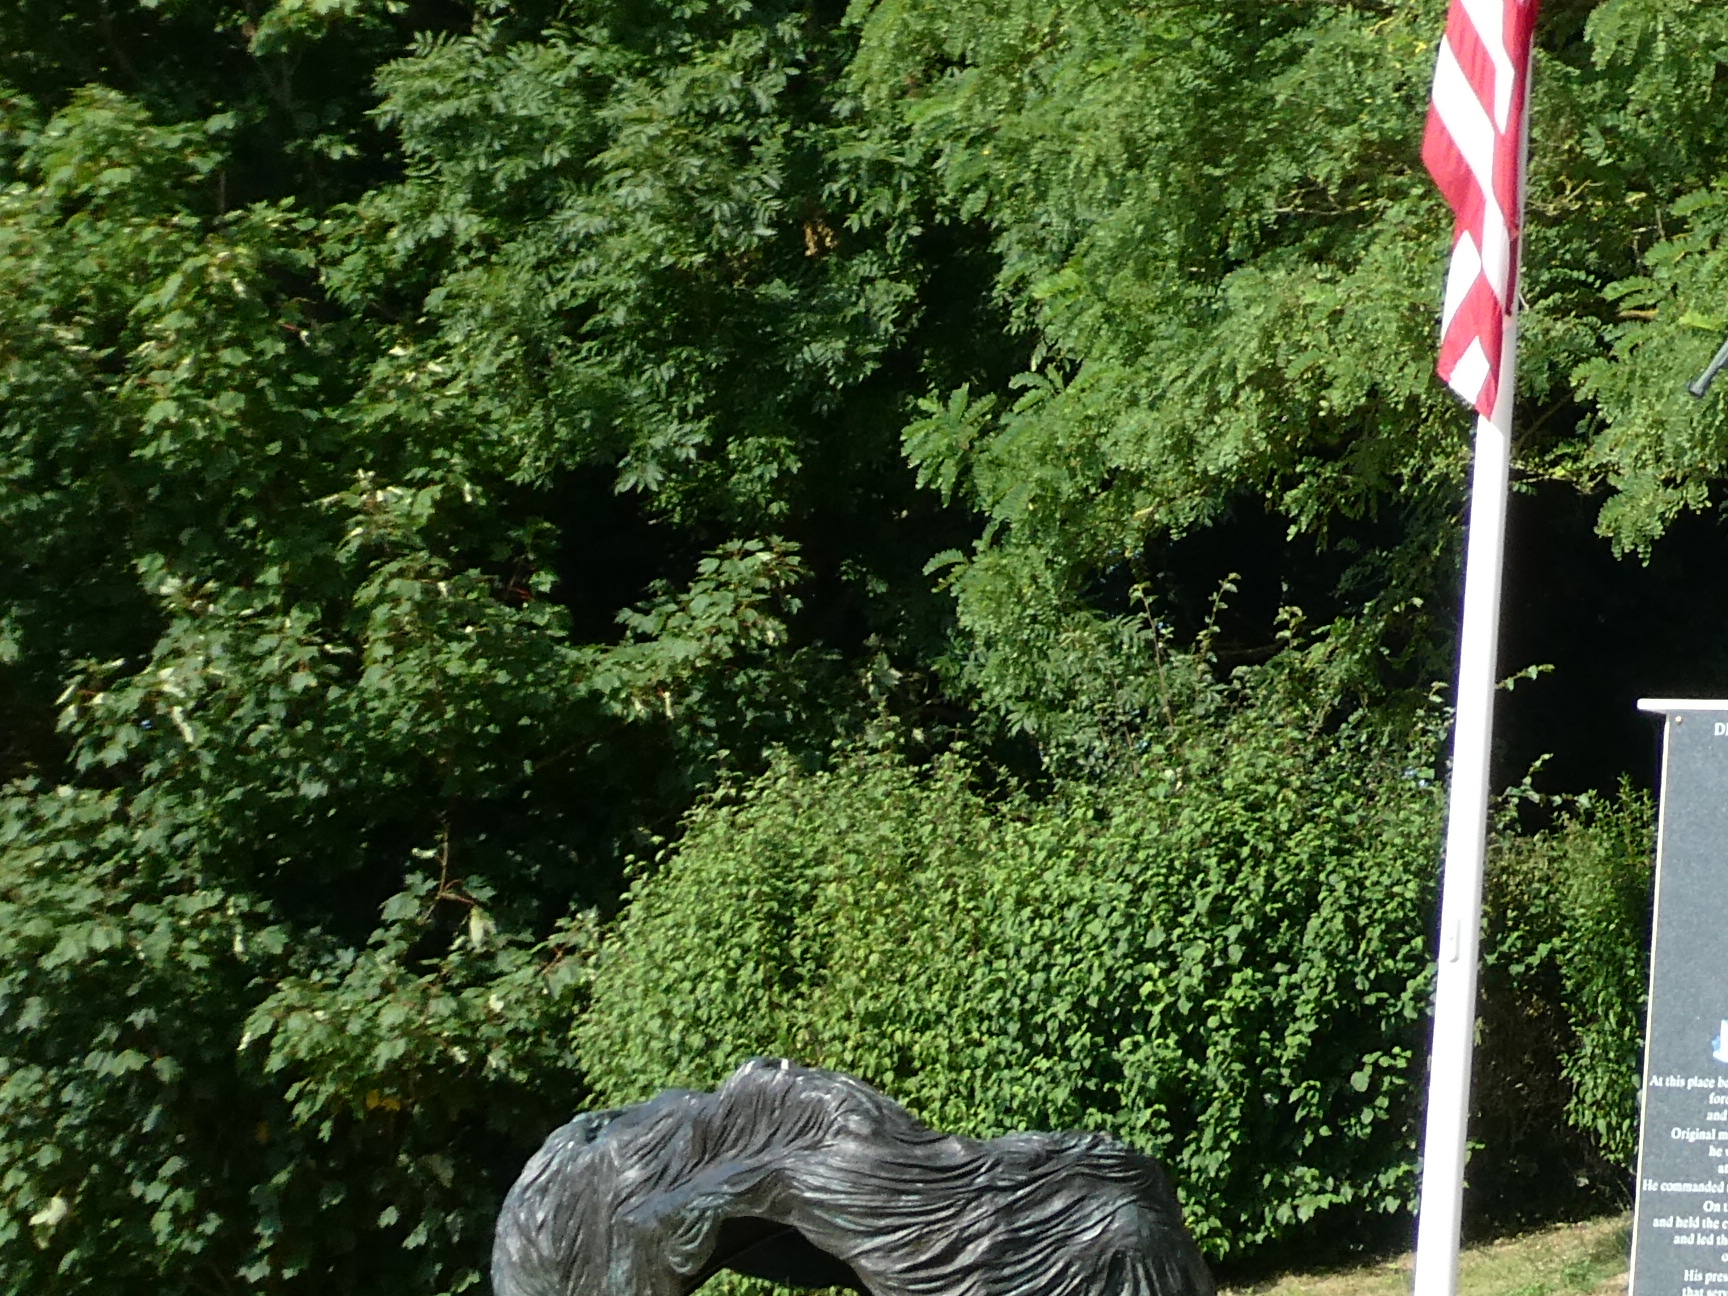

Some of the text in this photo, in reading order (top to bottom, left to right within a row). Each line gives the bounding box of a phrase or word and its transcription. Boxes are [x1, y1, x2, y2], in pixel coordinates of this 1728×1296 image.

[1649, 1075, 1662, 1086] At
[1665, 1074, 1685, 1087] this
[1686, 1075, 1714, 1091] place
[1706, 1108, 1727, 1121] and
[1671, 1127, 1715, 1143] Original
[1709, 1145, 1722, 1157] he
[1718, 1163, 1728, 1174] at
[1642, 1178, 1658, 1192] He
[1660, 1179, 1723, 1194] commanded
[1703, 1200, 1720, 1212] On
[1653, 1215, 1673, 1228] and
[1675, 1215, 1699, 1229] held
[1702, 1216, 1719, 1229] the
[1674, 1232, 1694, 1245] and
[1697, 1232, 1713, 1246] led
[1684, 1269, 1702, 1282] His
